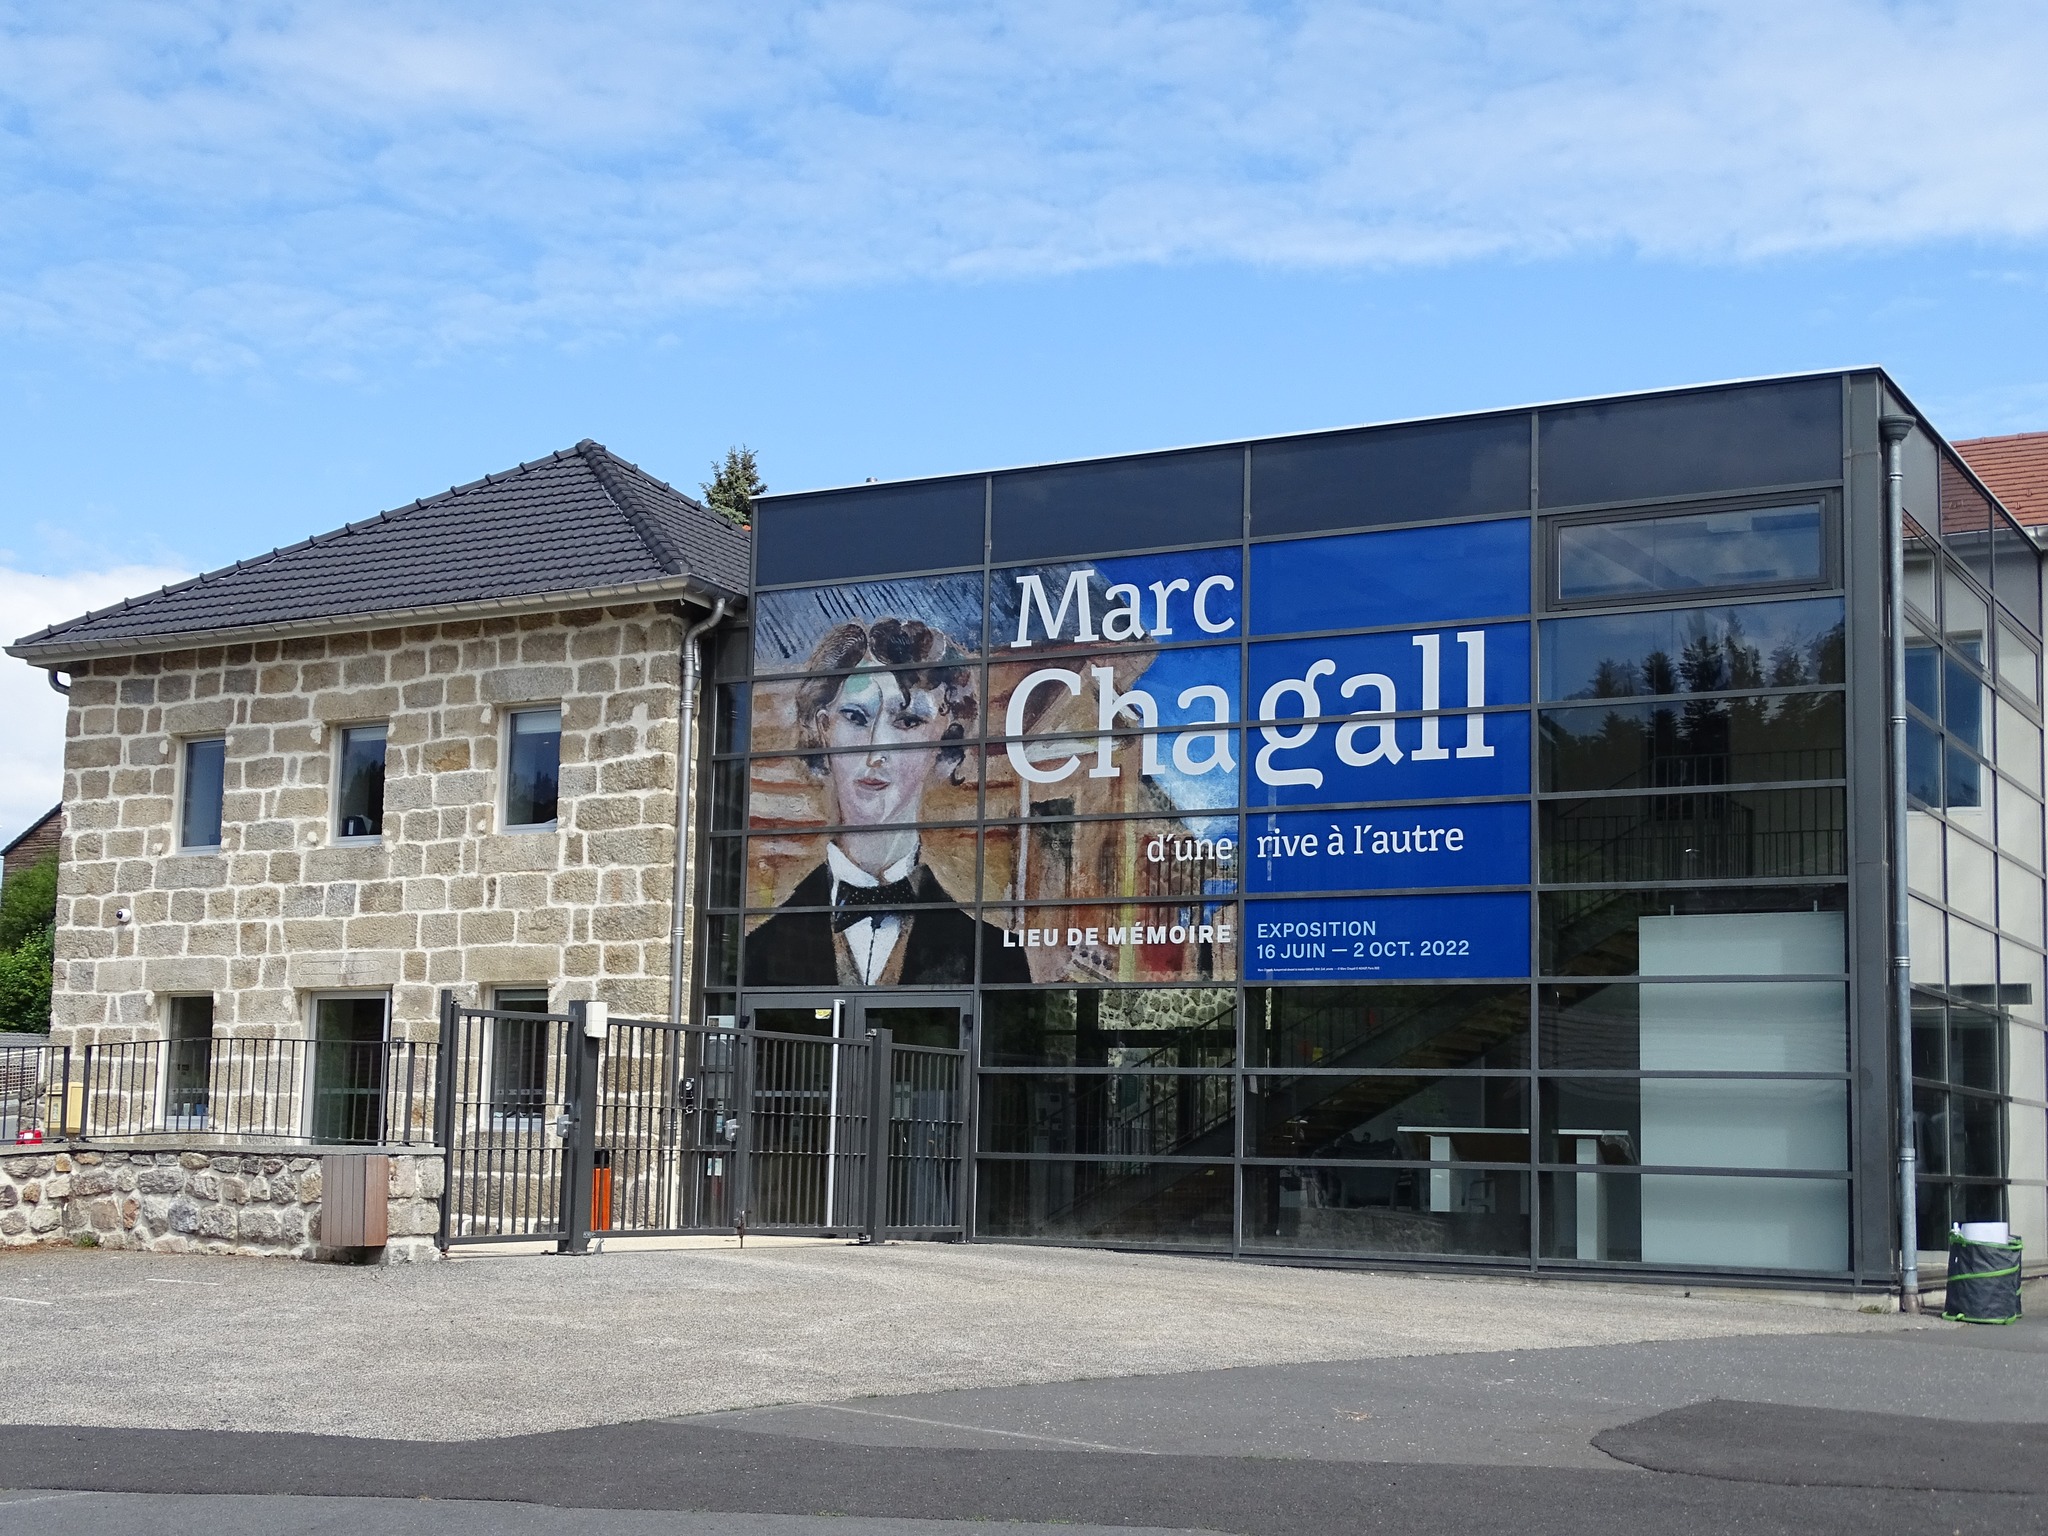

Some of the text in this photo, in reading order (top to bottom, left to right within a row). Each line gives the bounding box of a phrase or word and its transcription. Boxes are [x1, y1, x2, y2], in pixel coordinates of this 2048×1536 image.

[1011, 569, 1235, 648] Marc
[1005, 630, 1495, 790] Chagall
[1147, 824, 1464, 863] d'une rive à l'autre
[1003, 921, 1231, 948] LIEU DE MÉMOIRE
[1257, 921, 1376, 939] EXPOSITION
[1256, 943, 1276, 959] 16
[1280, 943, 1325, 959] JUIN
[1353, 942, 1365, 958] 2
[1369, 941, 1414, 957] OCT.
[1420, 940, 1470, 956] 2022
